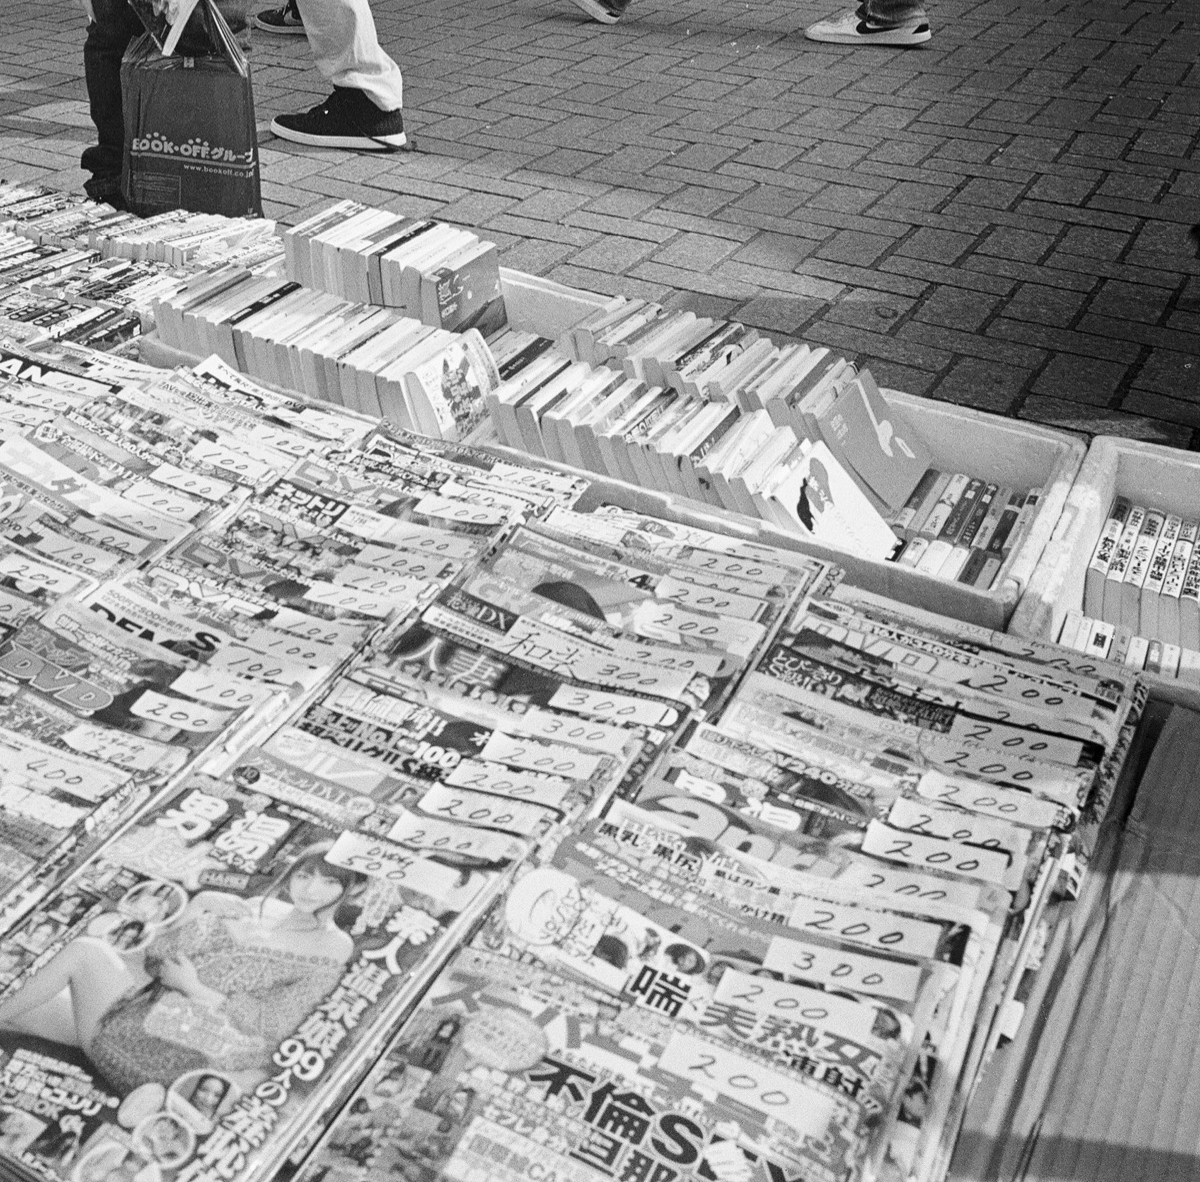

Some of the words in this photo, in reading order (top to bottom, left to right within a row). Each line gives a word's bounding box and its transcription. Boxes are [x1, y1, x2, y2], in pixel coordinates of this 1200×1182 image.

[166, 475, 212, 494] 100
[431, 505, 488, 520] 100
[402, 535, 449, 550] 100
[372, 554, 426, 572] 100
[701, 558, 763, 576] 200
[352, 576, 406, 592] 100
[317, 591, 378, 610] 100
[669, 588, 729, 608] 200
[286, 621, 339, 640] 100
[653, 614, 719, 635] 200
[268, 640, 316, 659] 100
[227, 658, 282, 676] 100
[599, 664, 658, 686] 300
[196, 684, 253, 703] 100
[979, 674, 1064, 706] 200
[146, 702, 209, 728] 200
[568, 692, 637, 716] 300
[542, 720, 605, 741] 300
[963, 725, 1049, 752] 200
[500, 748, 576, 772] 200
[943, 751, 1034, 782] 200
[26, 759, 83, 785] 400
[463, 773, 535, 797] 200
[936, 785, 1019, 813] 200
[438, 799, 513, 824] 200
[404, 830, 472, 850] 200
[885, 839, 980, 871] 200
[804, 910, 905, 945] 200
[792, 952, 883, 986] 300
[732, 985, 829, 1020] 200
[687, 1054, 790, 1106] 200
